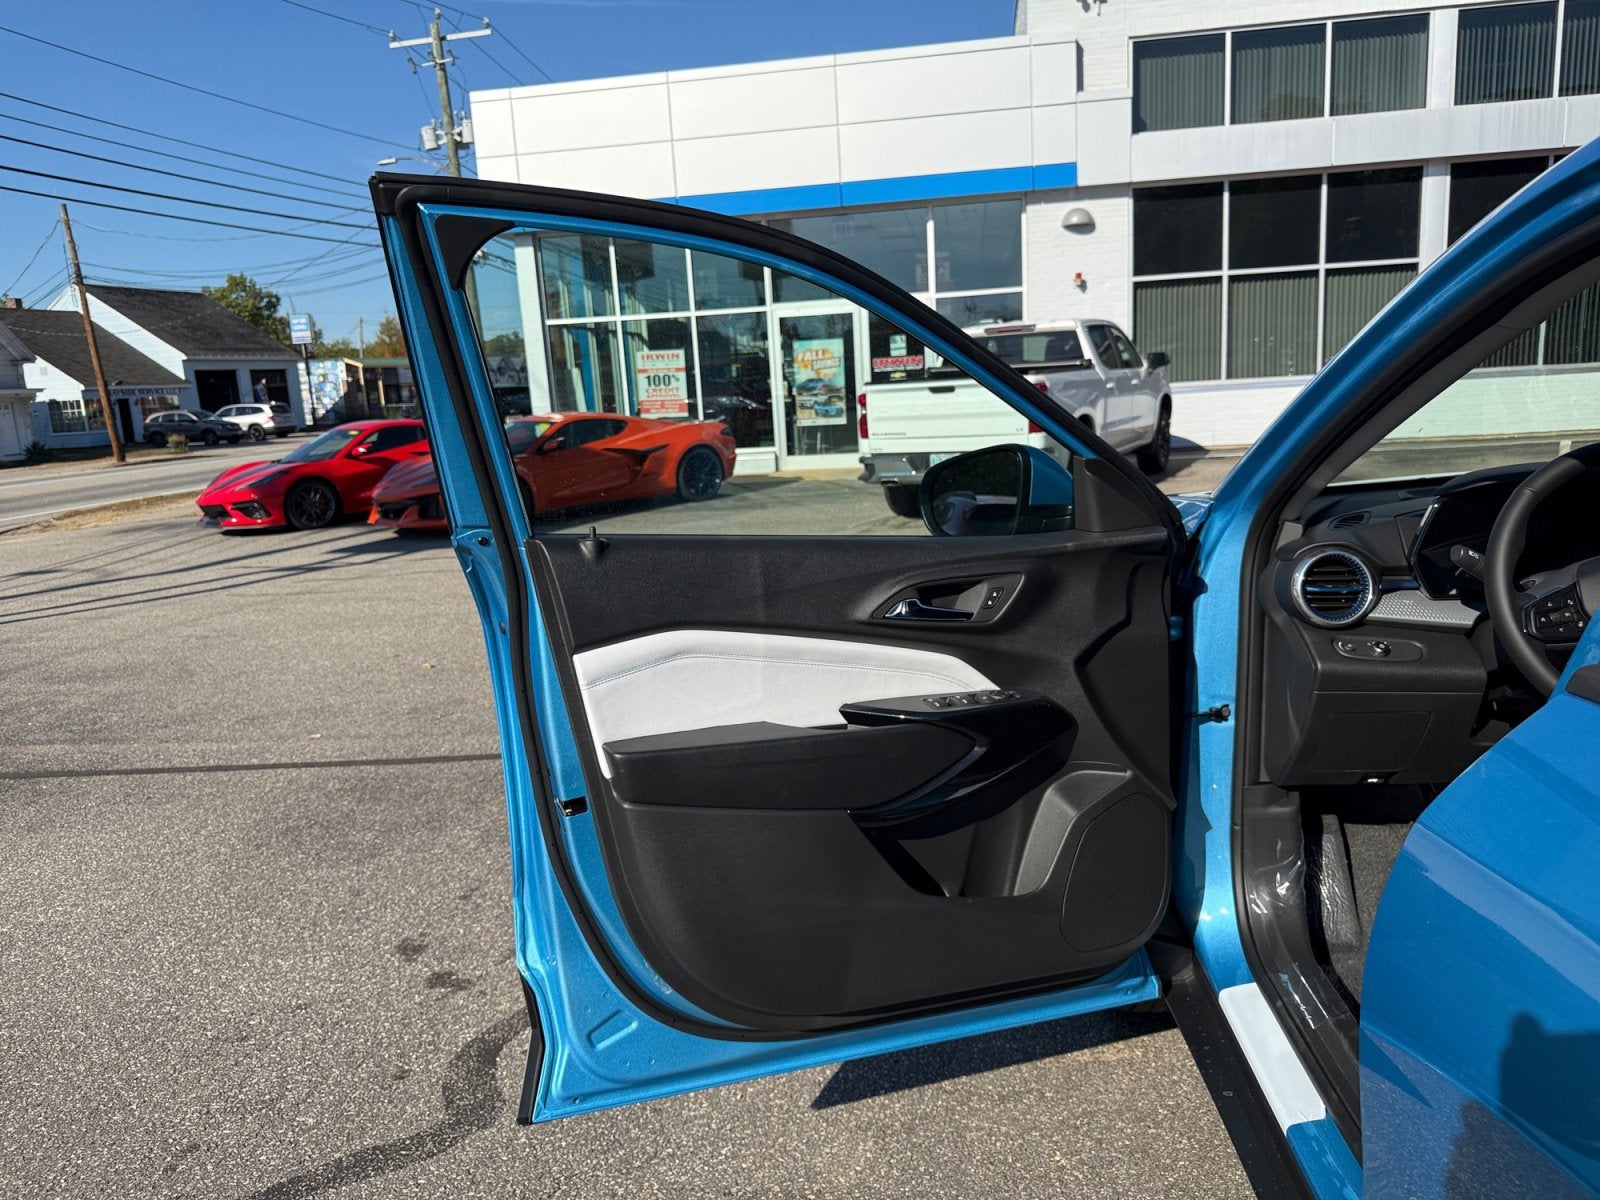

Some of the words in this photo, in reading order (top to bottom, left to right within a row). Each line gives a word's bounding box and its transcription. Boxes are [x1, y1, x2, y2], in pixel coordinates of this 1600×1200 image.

[797, 349, 826, 362] FALL
[872, 355, 923, 368] IRWIN
[644, 374, 680, 388] 100%
